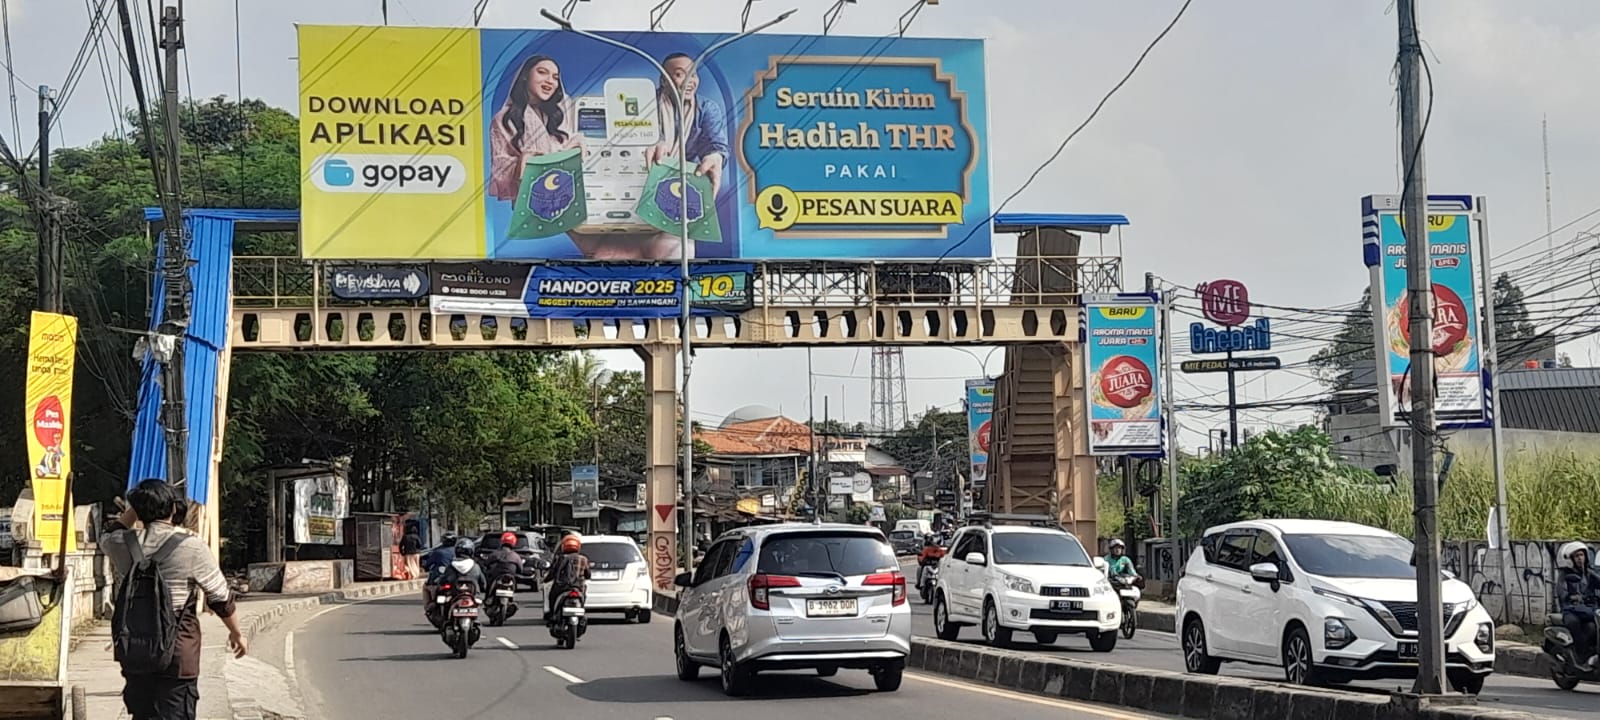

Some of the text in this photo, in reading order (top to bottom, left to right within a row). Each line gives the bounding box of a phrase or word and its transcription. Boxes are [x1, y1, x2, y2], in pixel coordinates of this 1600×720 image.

[776, 87, 936, 109] Seruin Kirim
[308, 96, 465, 116] DOWNLOAD
[309, 122, 466, 146] APLIKASI
[759, 121, 956, 149] Hadiah THR
[362, 163, 452, 188] gopay
[824, 164, 897, 178] PAKAI
[801, 198, 957, 216] PESAN SUARA
[1427, 215, 1445, 226] RU
[1387, 244, 1467, 255] ARO MANIS
[539, 280, 675, 294] HANDOVER 2025
[699, 275, 734, 297] 10
[539, 298, 573, 306] BIGGEST
[1109, 307, 1138, 316] BARU
[1092, 328, 1154, 336] AROMA MANIS
[1098, 337, 1127, 345] JUARA
[1184, 361, 1200, 370] MIE
[1201, 361, 1227, 369] PEDAS
[1108, 373, 1147, 392] JUARA
[809, 601, 815, 610] B
